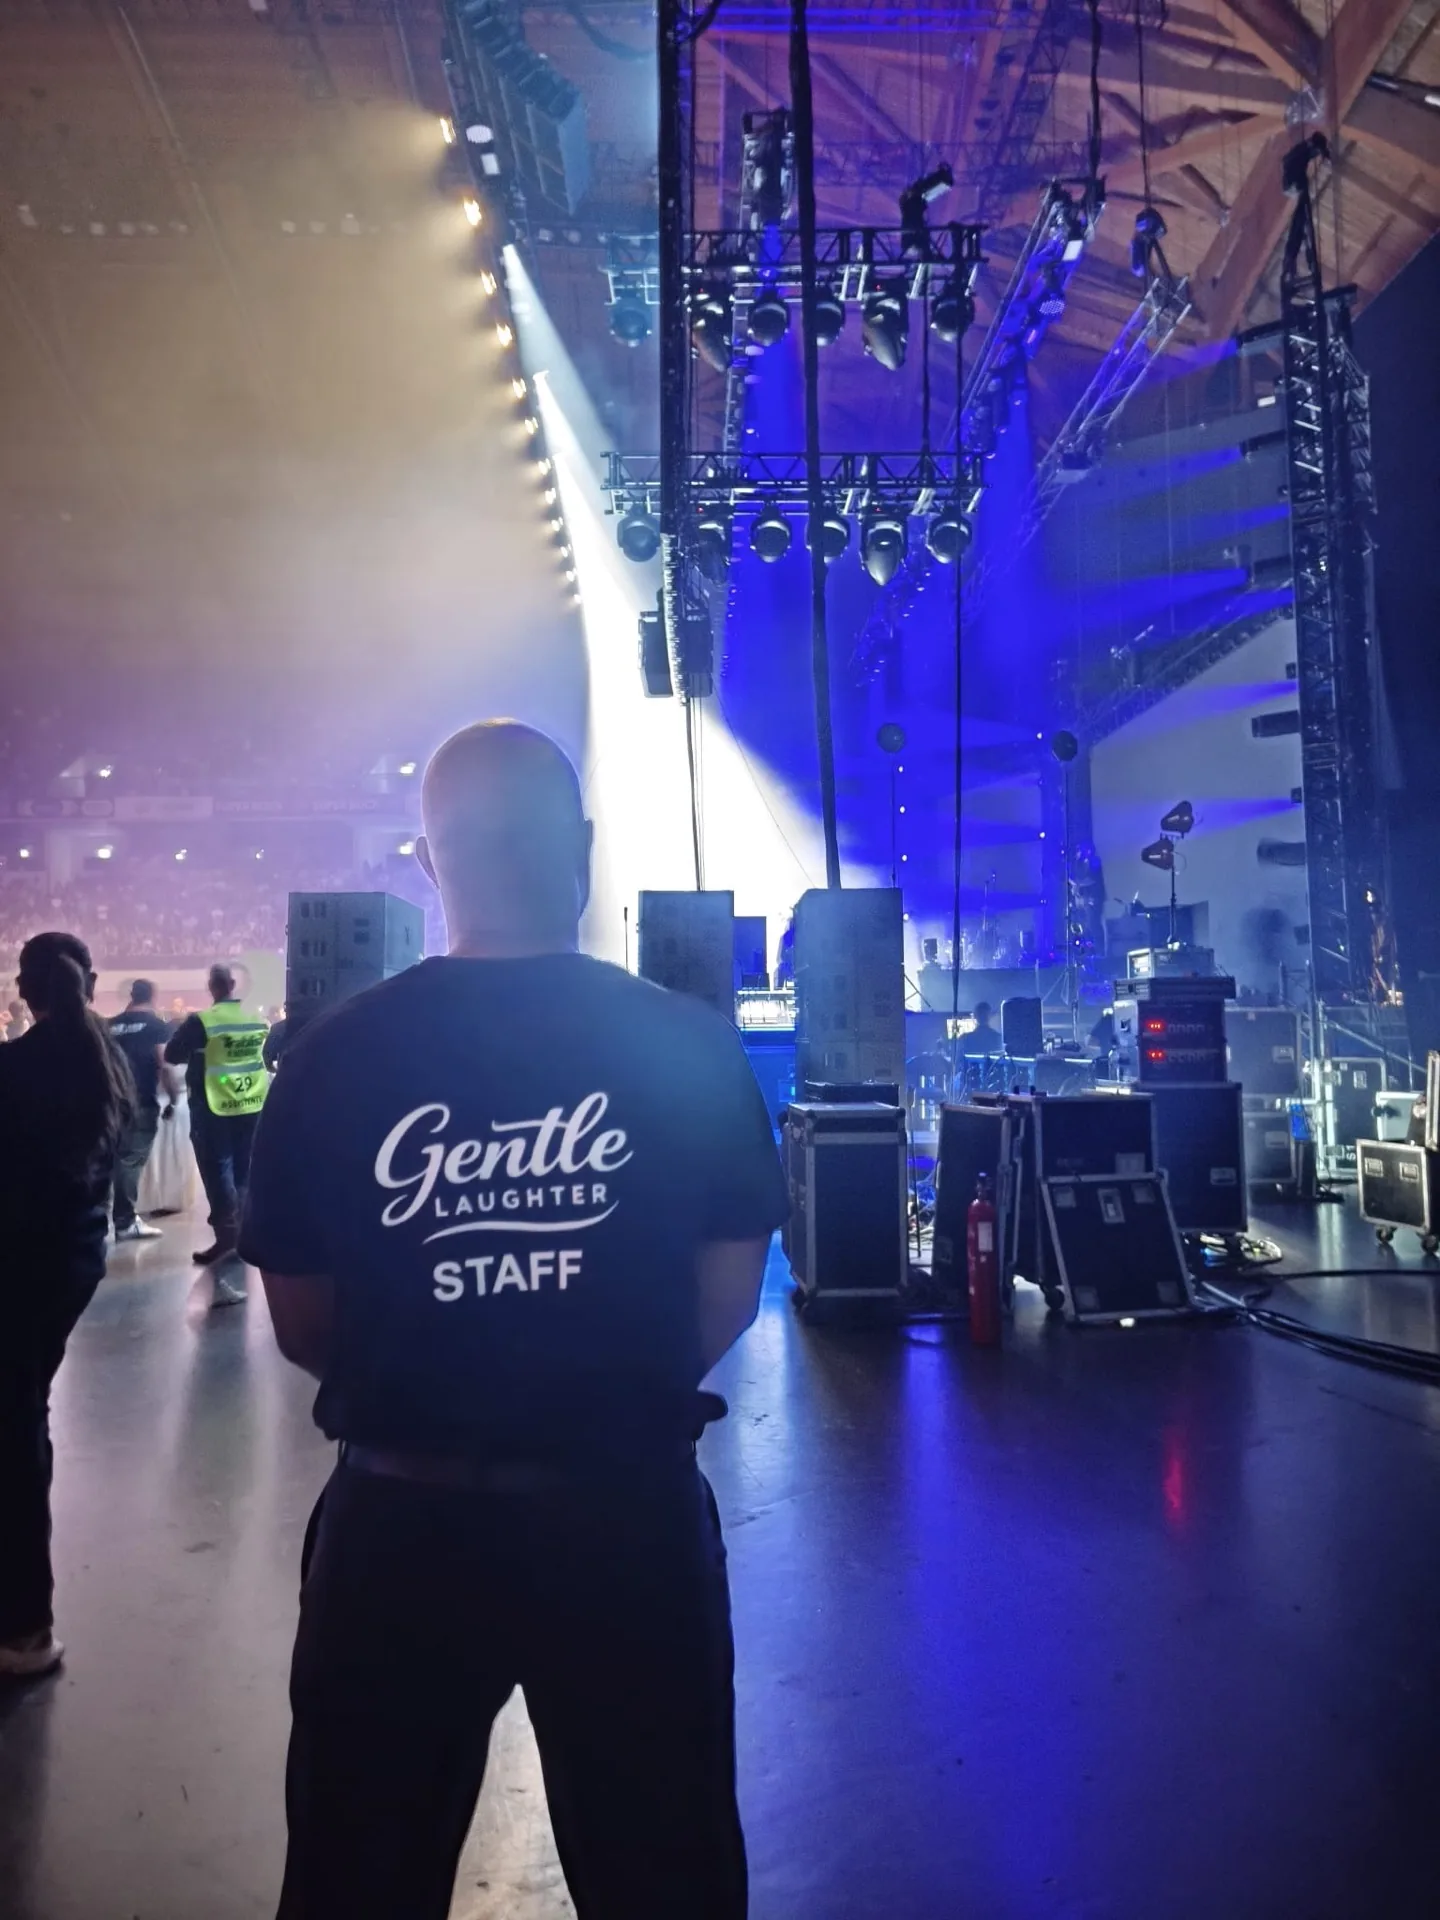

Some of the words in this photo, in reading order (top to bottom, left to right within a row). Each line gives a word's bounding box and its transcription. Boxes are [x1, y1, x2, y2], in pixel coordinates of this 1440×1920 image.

[234, 1076, 252, 1092] 29
[374, 1091, 634, 1227] Gentle
[434, 1183, 607, 1218] LAUGHTER
[432, 1249, 583, 1302] STAFF
